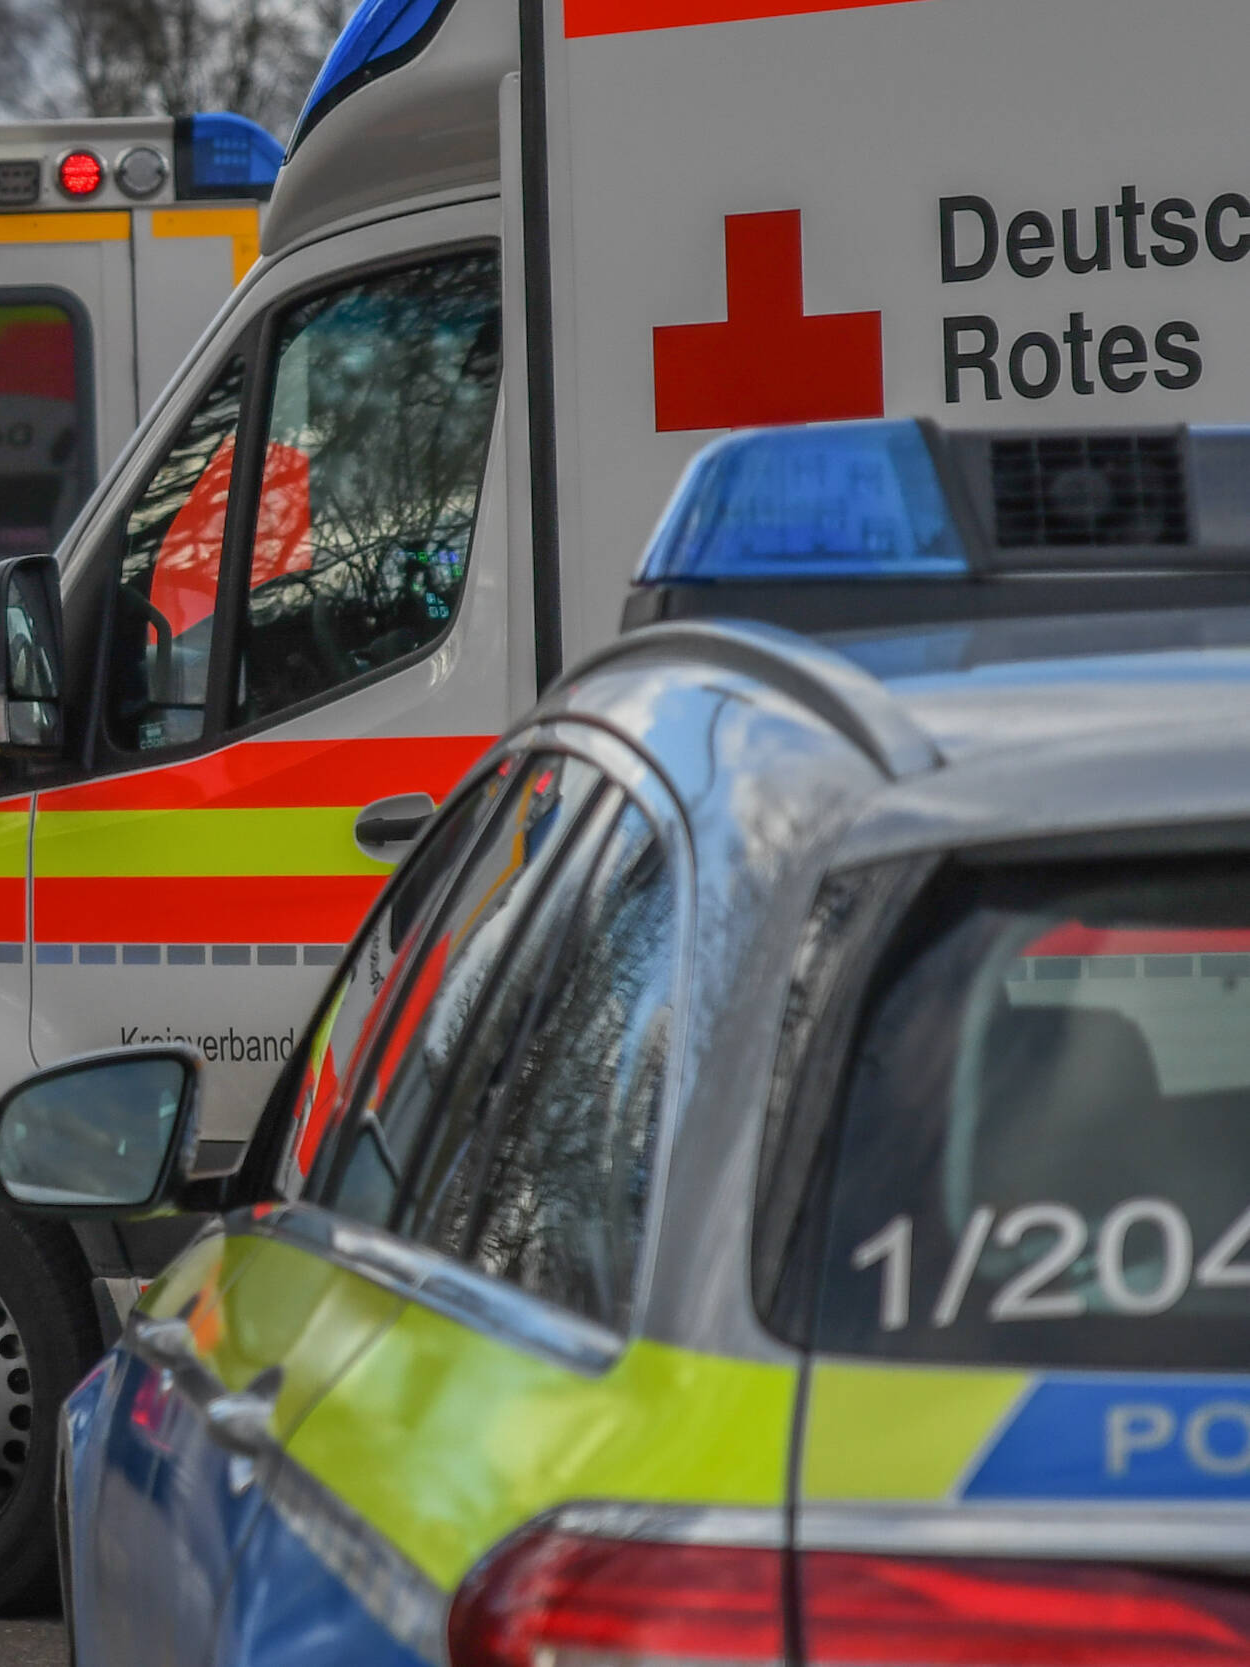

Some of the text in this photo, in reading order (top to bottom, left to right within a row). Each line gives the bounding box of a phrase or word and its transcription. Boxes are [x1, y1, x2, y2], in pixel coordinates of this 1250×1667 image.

[939, 184, 1250, 284] Deutsc
[942, 312, 1204, 404] Rotes
[121, 1026, 294, 1062] Kerband
[1106, 1401, 1250, 1476] PO
